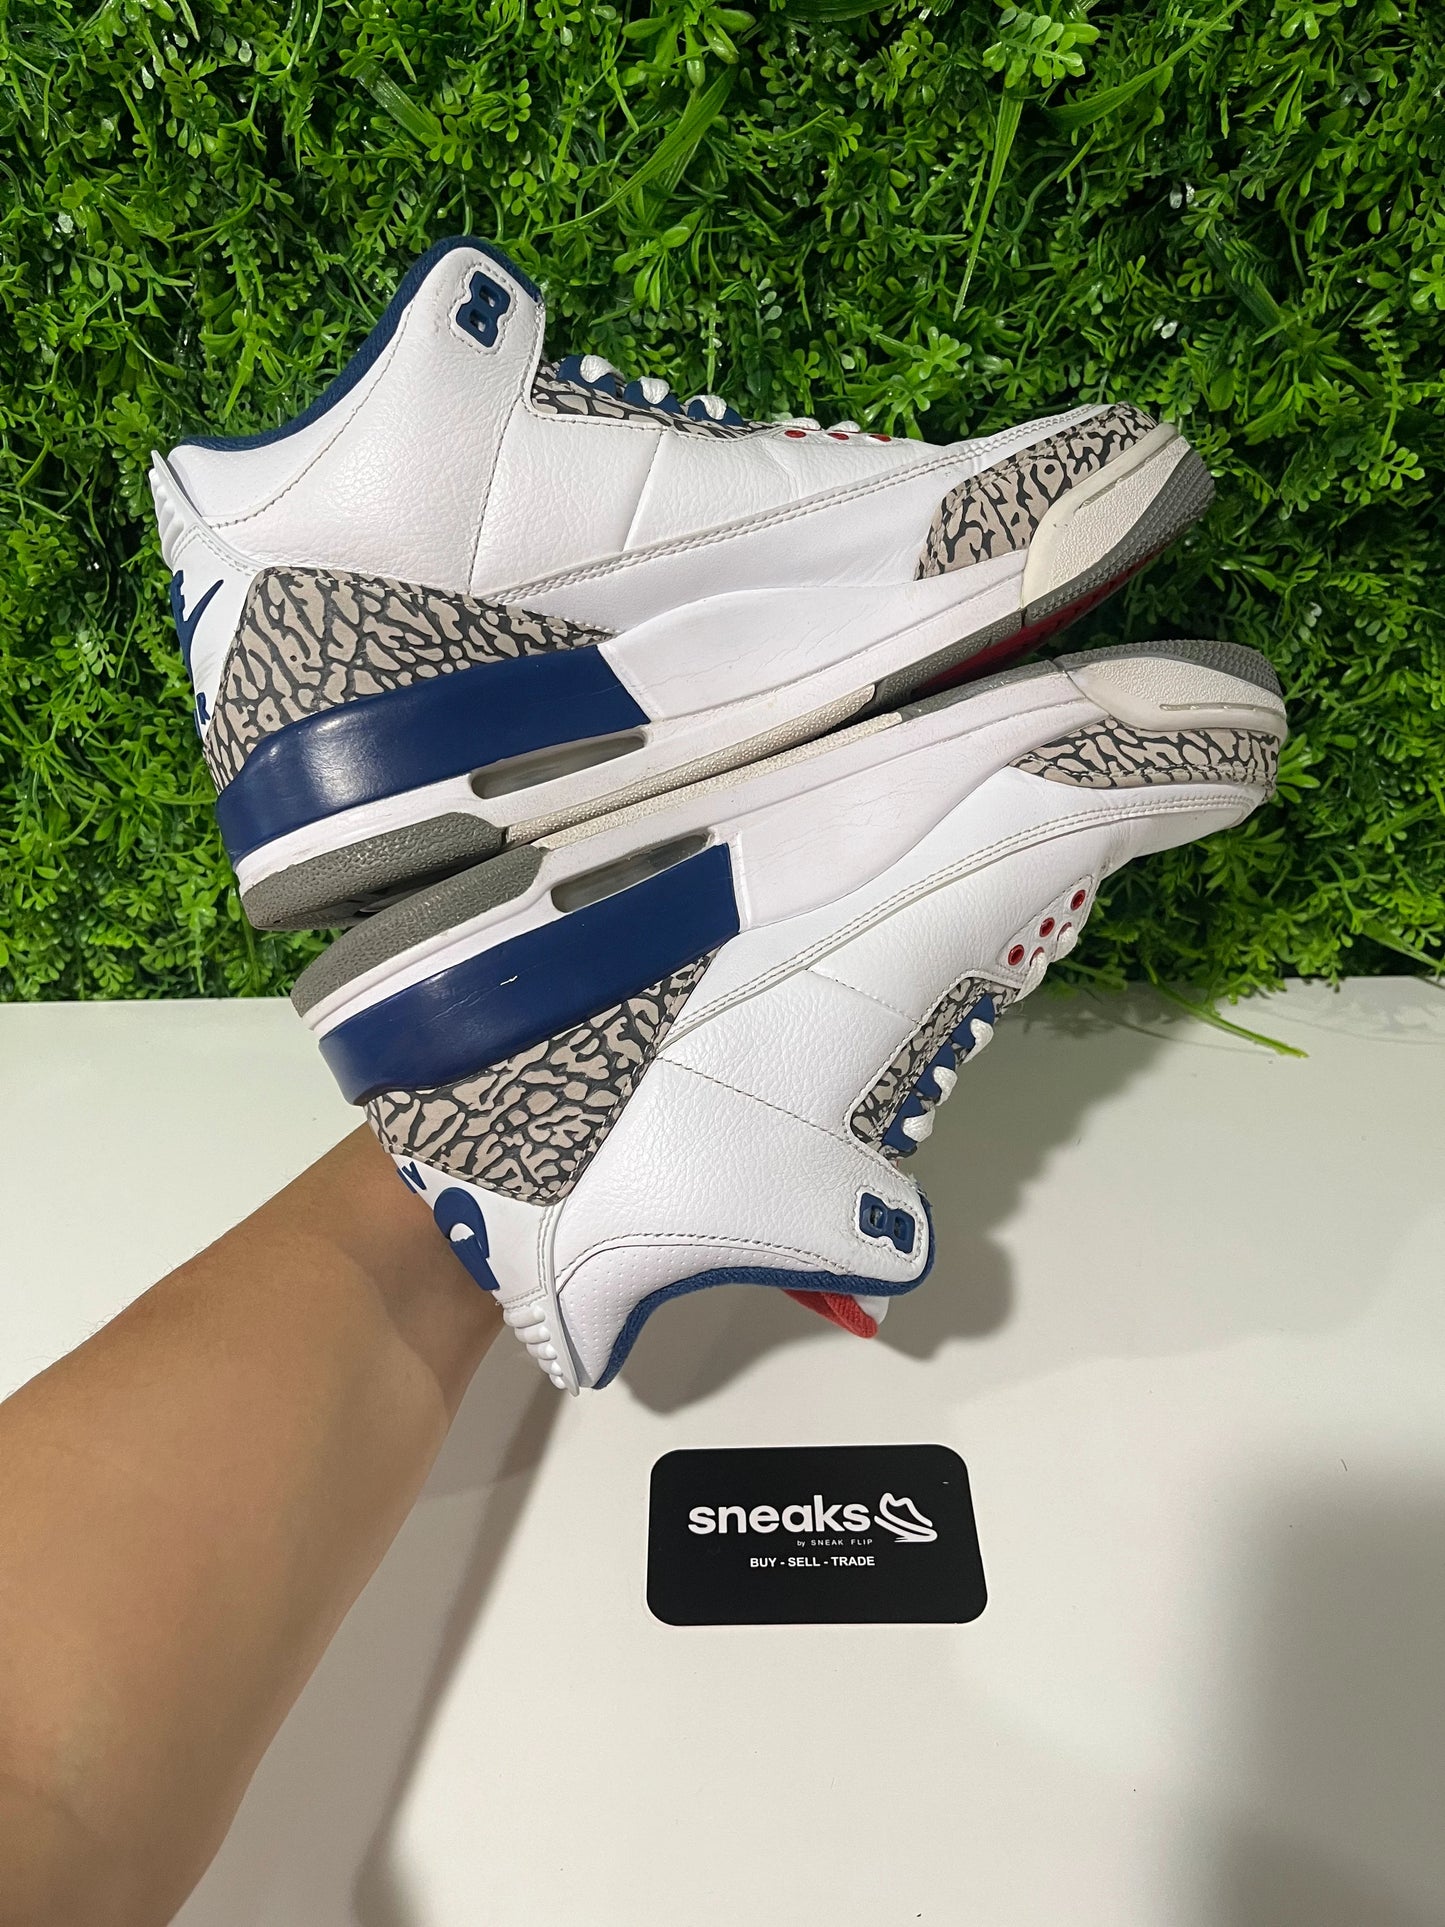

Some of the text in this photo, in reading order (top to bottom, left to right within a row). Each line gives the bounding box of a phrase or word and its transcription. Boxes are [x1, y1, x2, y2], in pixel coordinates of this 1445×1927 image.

[687, 1494, 871, 1535] sneaks
[796, 1539, 806, 1548] by
[850, 1538, 873, 1546] FLIP
[749, 1557, 777, 1568] BUY
[787, 1557, 821, 1567] SELL
[830, 1556, 876, 1567] TRADE
